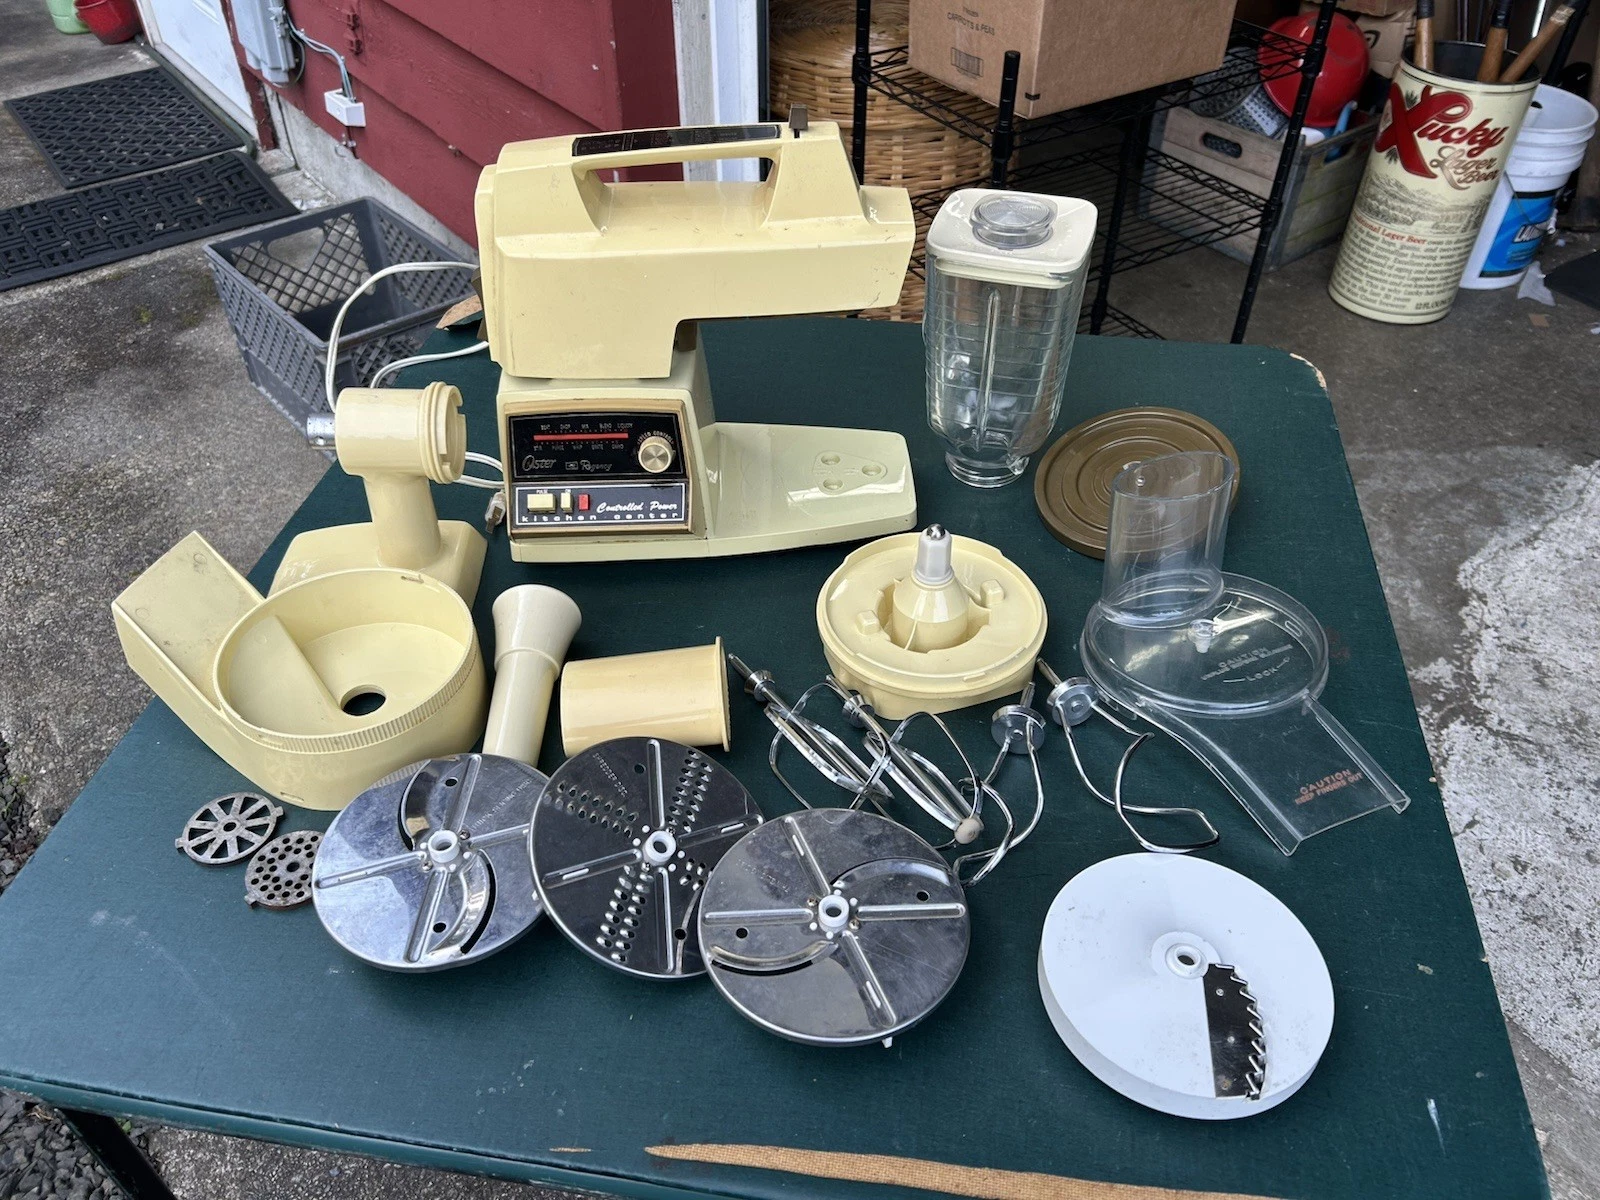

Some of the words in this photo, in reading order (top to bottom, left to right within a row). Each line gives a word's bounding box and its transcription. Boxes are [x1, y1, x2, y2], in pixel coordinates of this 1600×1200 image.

[981, 24, 995, 36] PEAS
[1375, 82, 1509, 179] Lucky
[1430, 146, 1497, 190] Lager
[1458, 169, 1499, 184] Beer
[1382, 228, 1405, 241] Lager
[1407, 235, 1426, 245] Beer
[522, 454, 557, 472] Oster
[580, 459, 613, 472] Regency
[596, 502, 644, 514] Controlled
[650, 501, 678, 511] Power
[521, 514, 597, 522] kitchen
[614, 512, 678, 520] center
[1219, 647, 1268, 667] CAUTION
[1246, 667, 1278, 681] LOCK
[1295, 792, 1315, 805] KEEP
[1316, 780, 1347, 796] FINGERS
[1348, 772, 1363, 783] OUT
[1300, 769, 1351, 795] CAUTION
